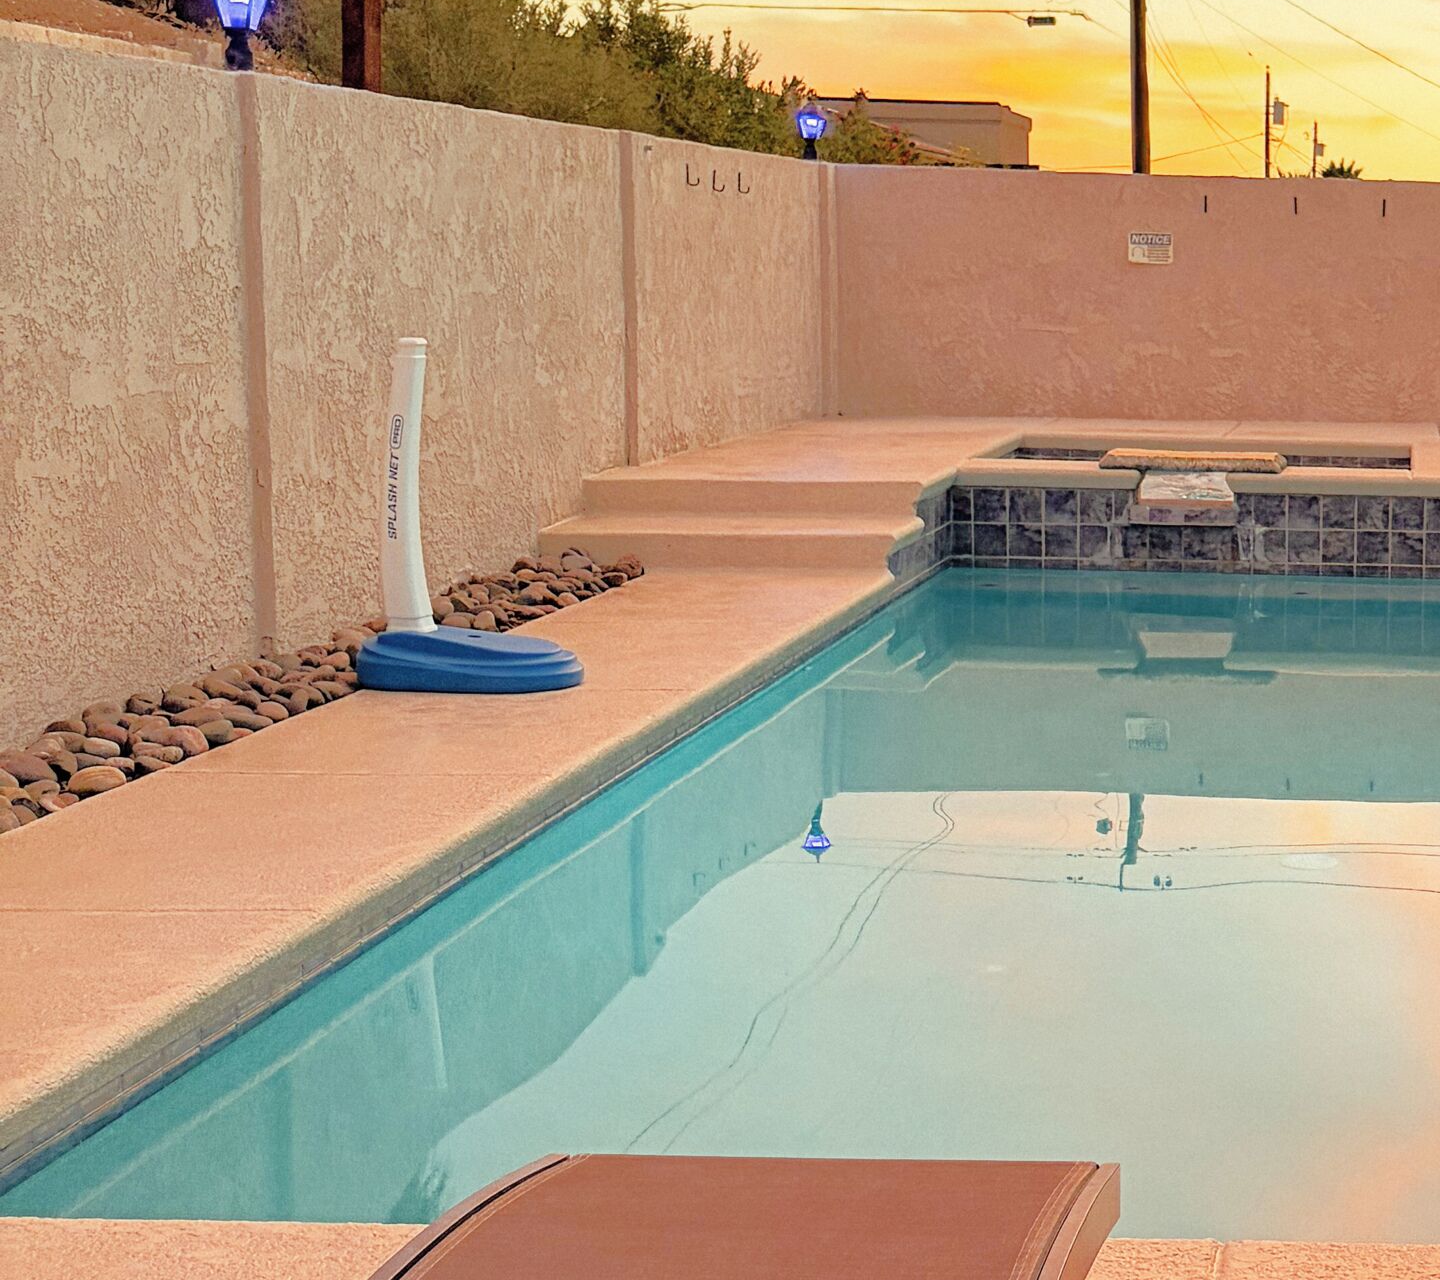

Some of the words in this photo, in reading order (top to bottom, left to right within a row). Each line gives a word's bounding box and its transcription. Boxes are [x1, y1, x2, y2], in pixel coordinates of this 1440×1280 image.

[1131, 234, 1170, 244] NOTICE
[388, 452, 400, 480] NET
[388, 483, 398, 540] SPLASH
